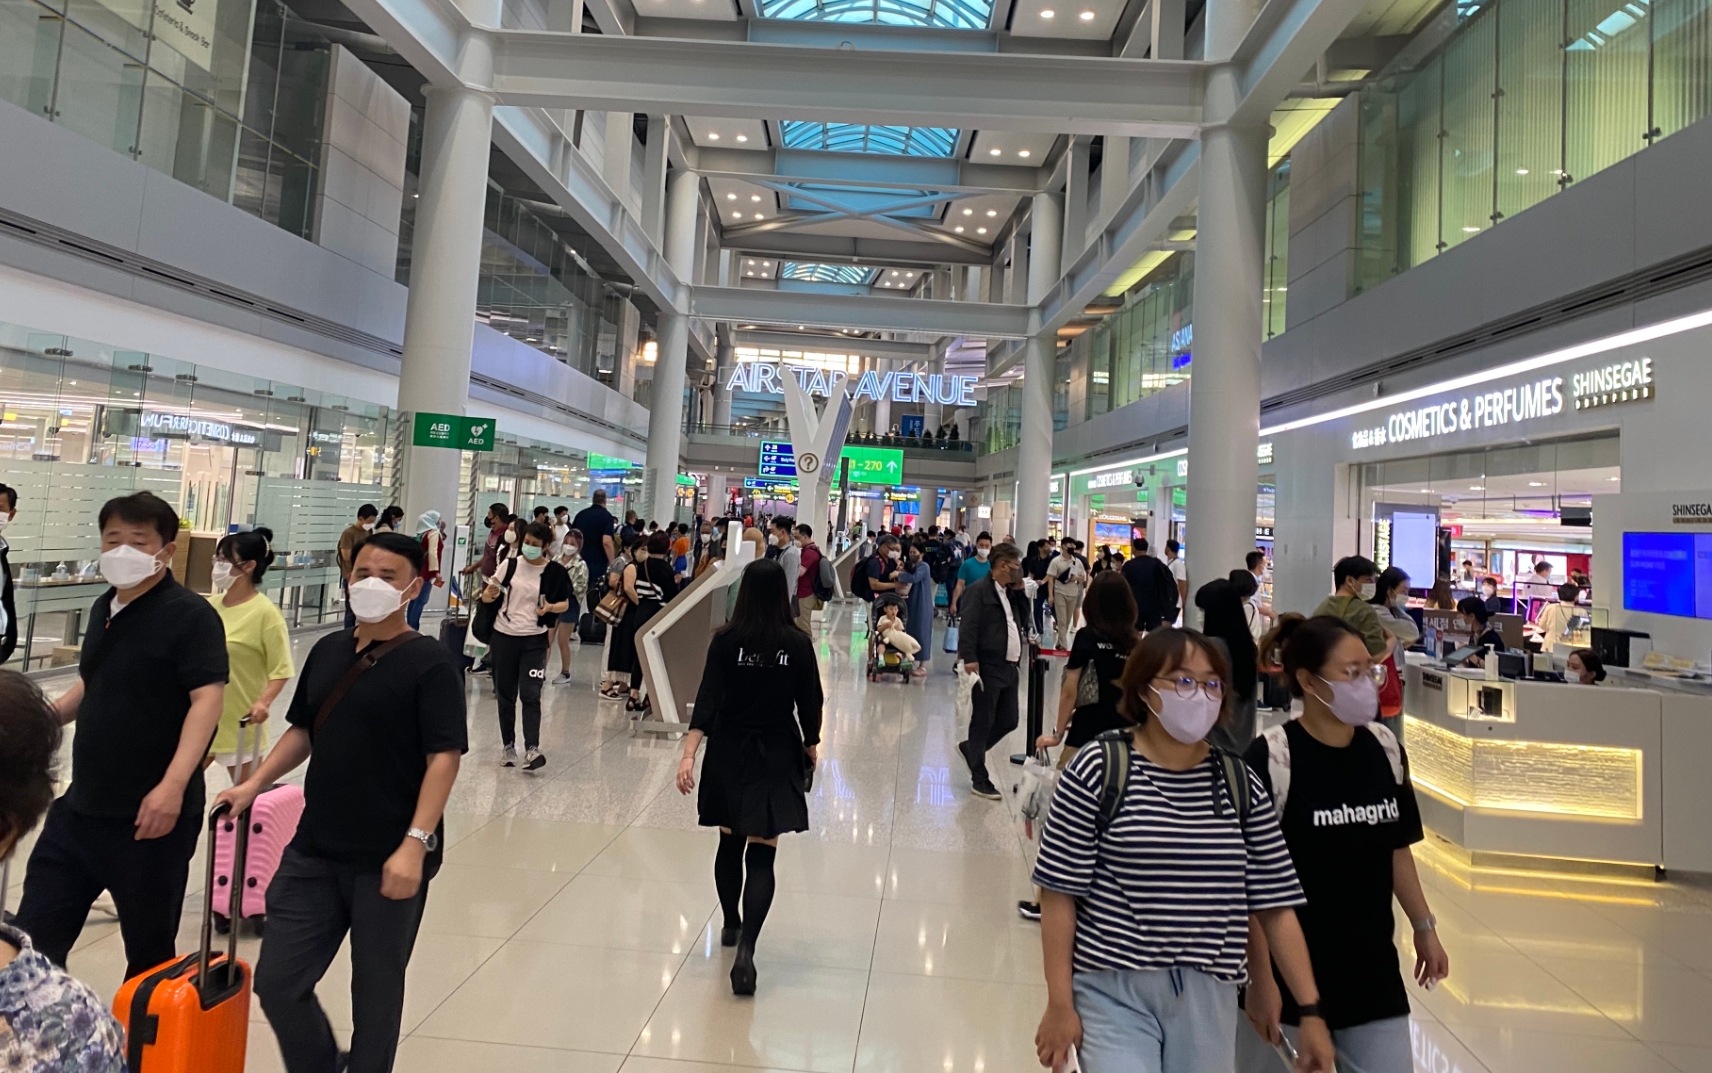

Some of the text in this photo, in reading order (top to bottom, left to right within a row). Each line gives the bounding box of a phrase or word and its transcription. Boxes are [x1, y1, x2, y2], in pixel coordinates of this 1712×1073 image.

[854, 370, 978, 406] AVENUE
[1573, 357, 1652, 397] SHINSEGAE
[430, 423, 450, 432] AED
[1388, 376, 1564, 443] COSMETICS & PERFUMES
[1313, 797, 1399, 826] mahagrid
